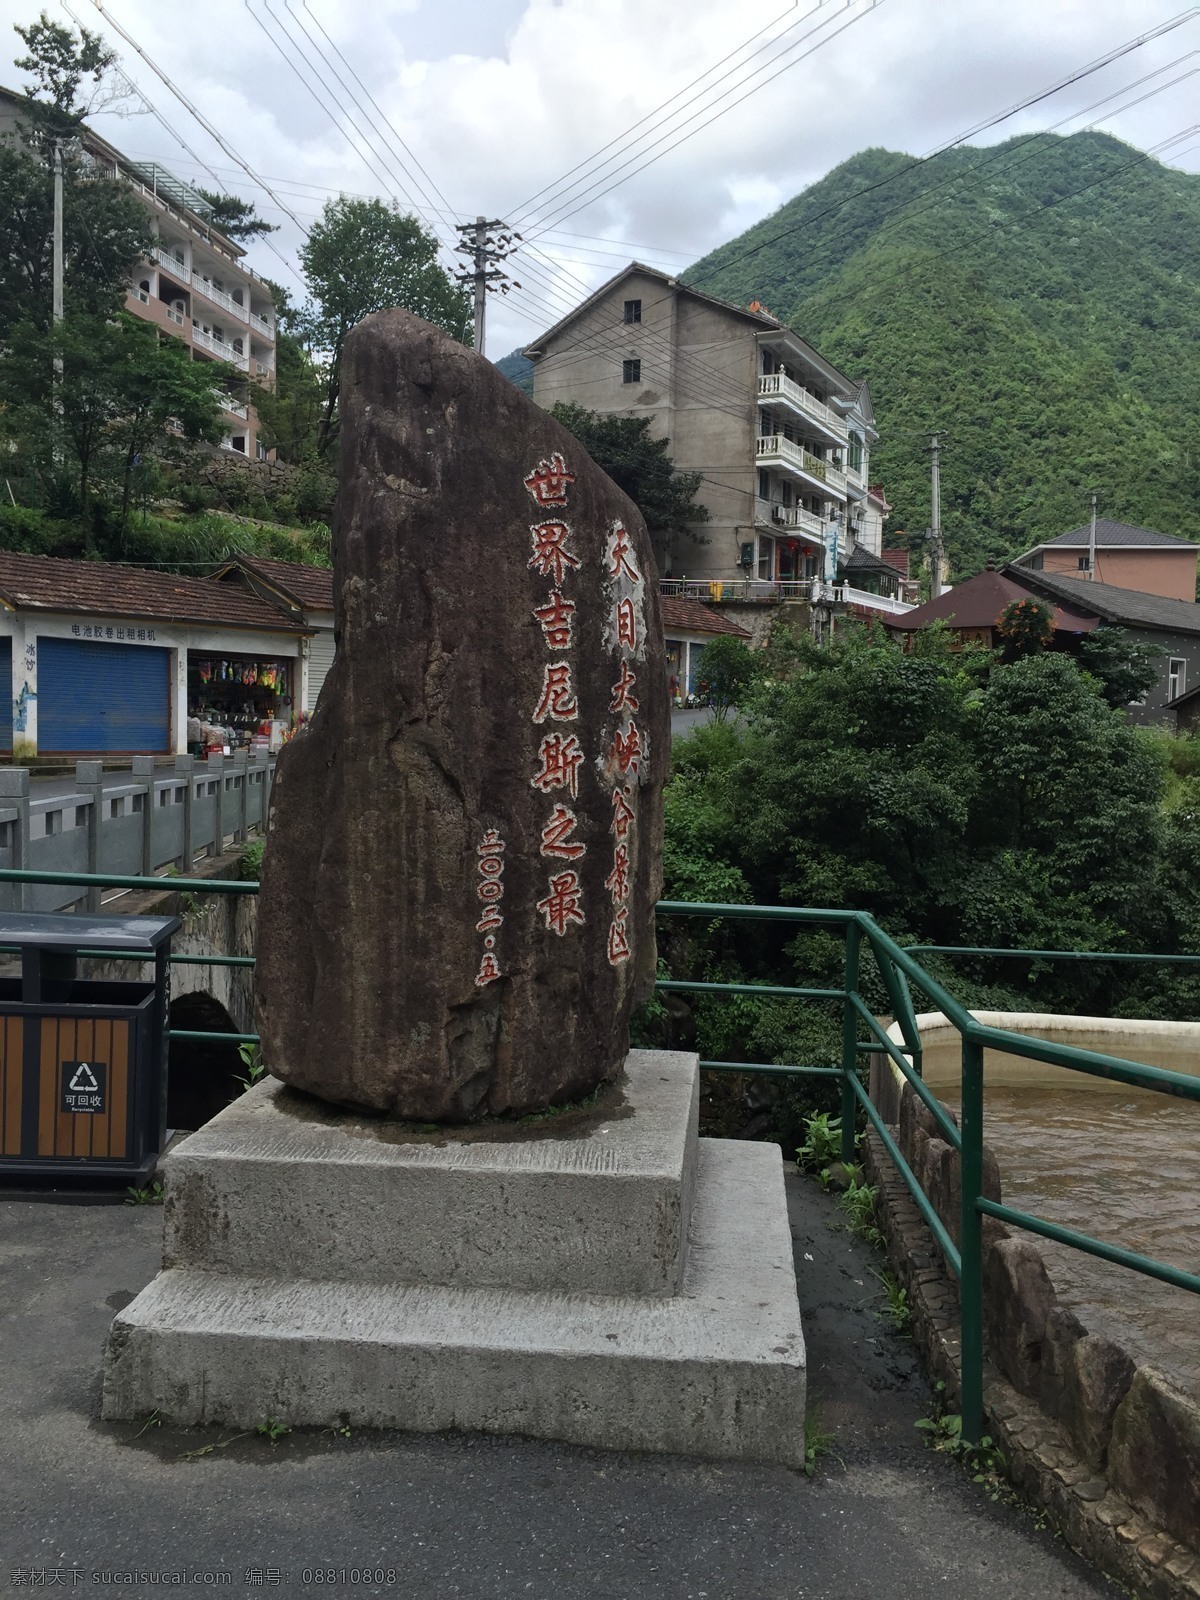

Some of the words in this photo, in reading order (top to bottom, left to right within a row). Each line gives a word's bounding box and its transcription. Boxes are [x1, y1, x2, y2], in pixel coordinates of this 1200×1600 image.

[71, 624, 156, 641] 电池胶卷出租相机
[523, 451, 588, 937] 世界吉尼斯之最
[604, 526, 642, 966] 天目大峡谷景区
[64, 1094, 102, 1107] 可回收
